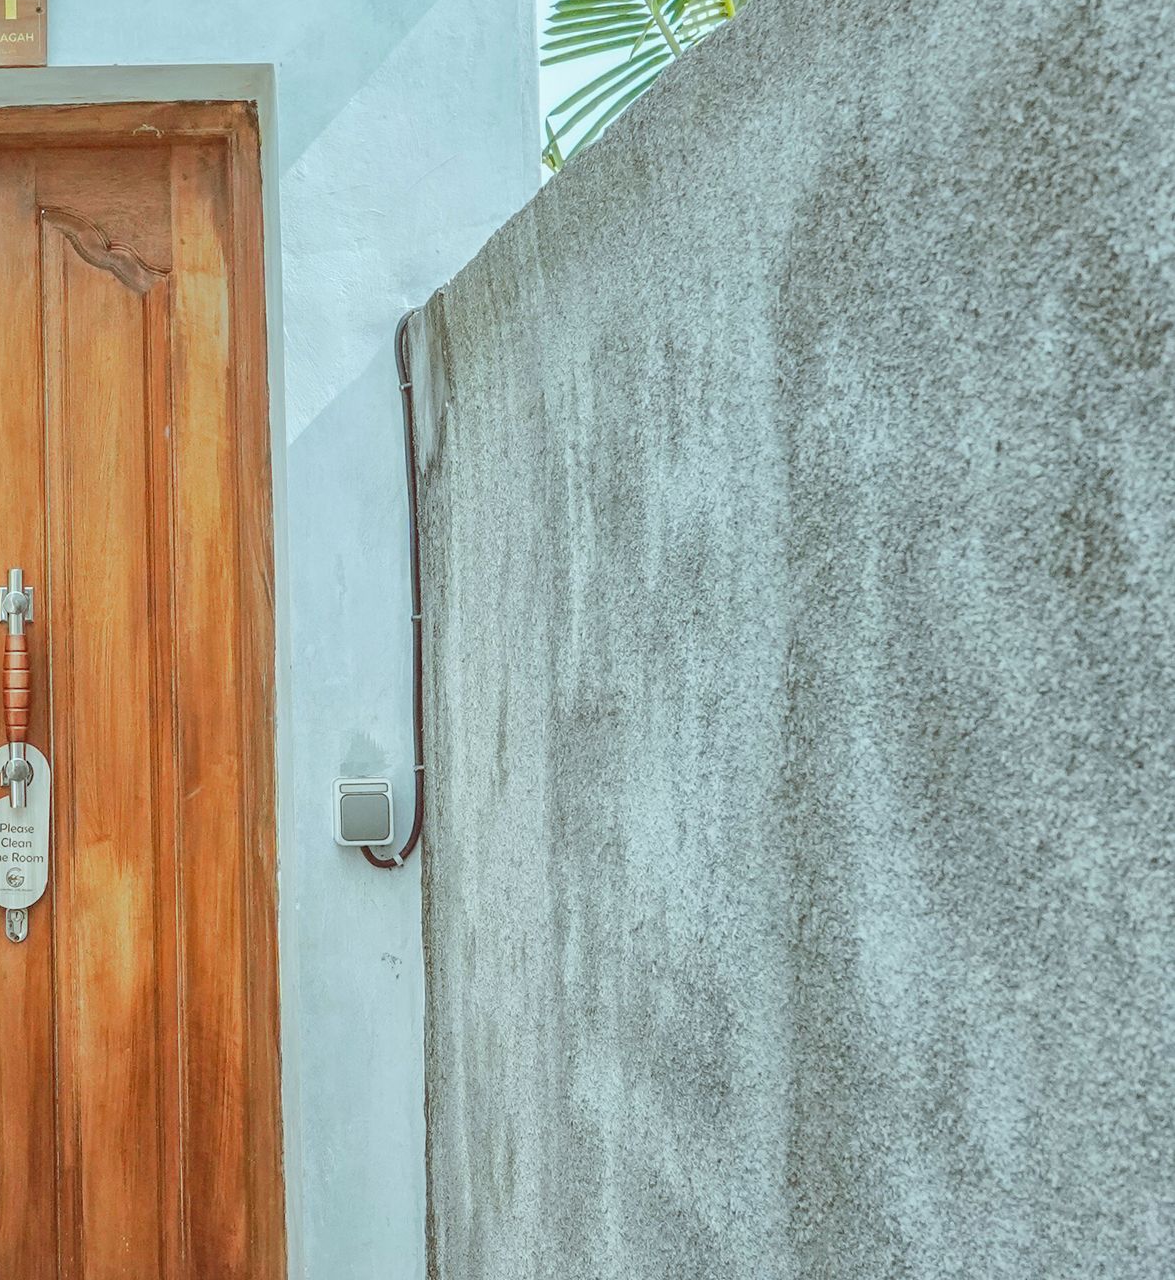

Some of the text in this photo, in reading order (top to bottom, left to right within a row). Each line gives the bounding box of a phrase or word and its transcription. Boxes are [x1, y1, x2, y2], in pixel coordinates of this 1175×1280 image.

[0, 822, 35, 834] Please
[0, 837, 33, 849] Clean
[11, 851, 44, 863] Room
